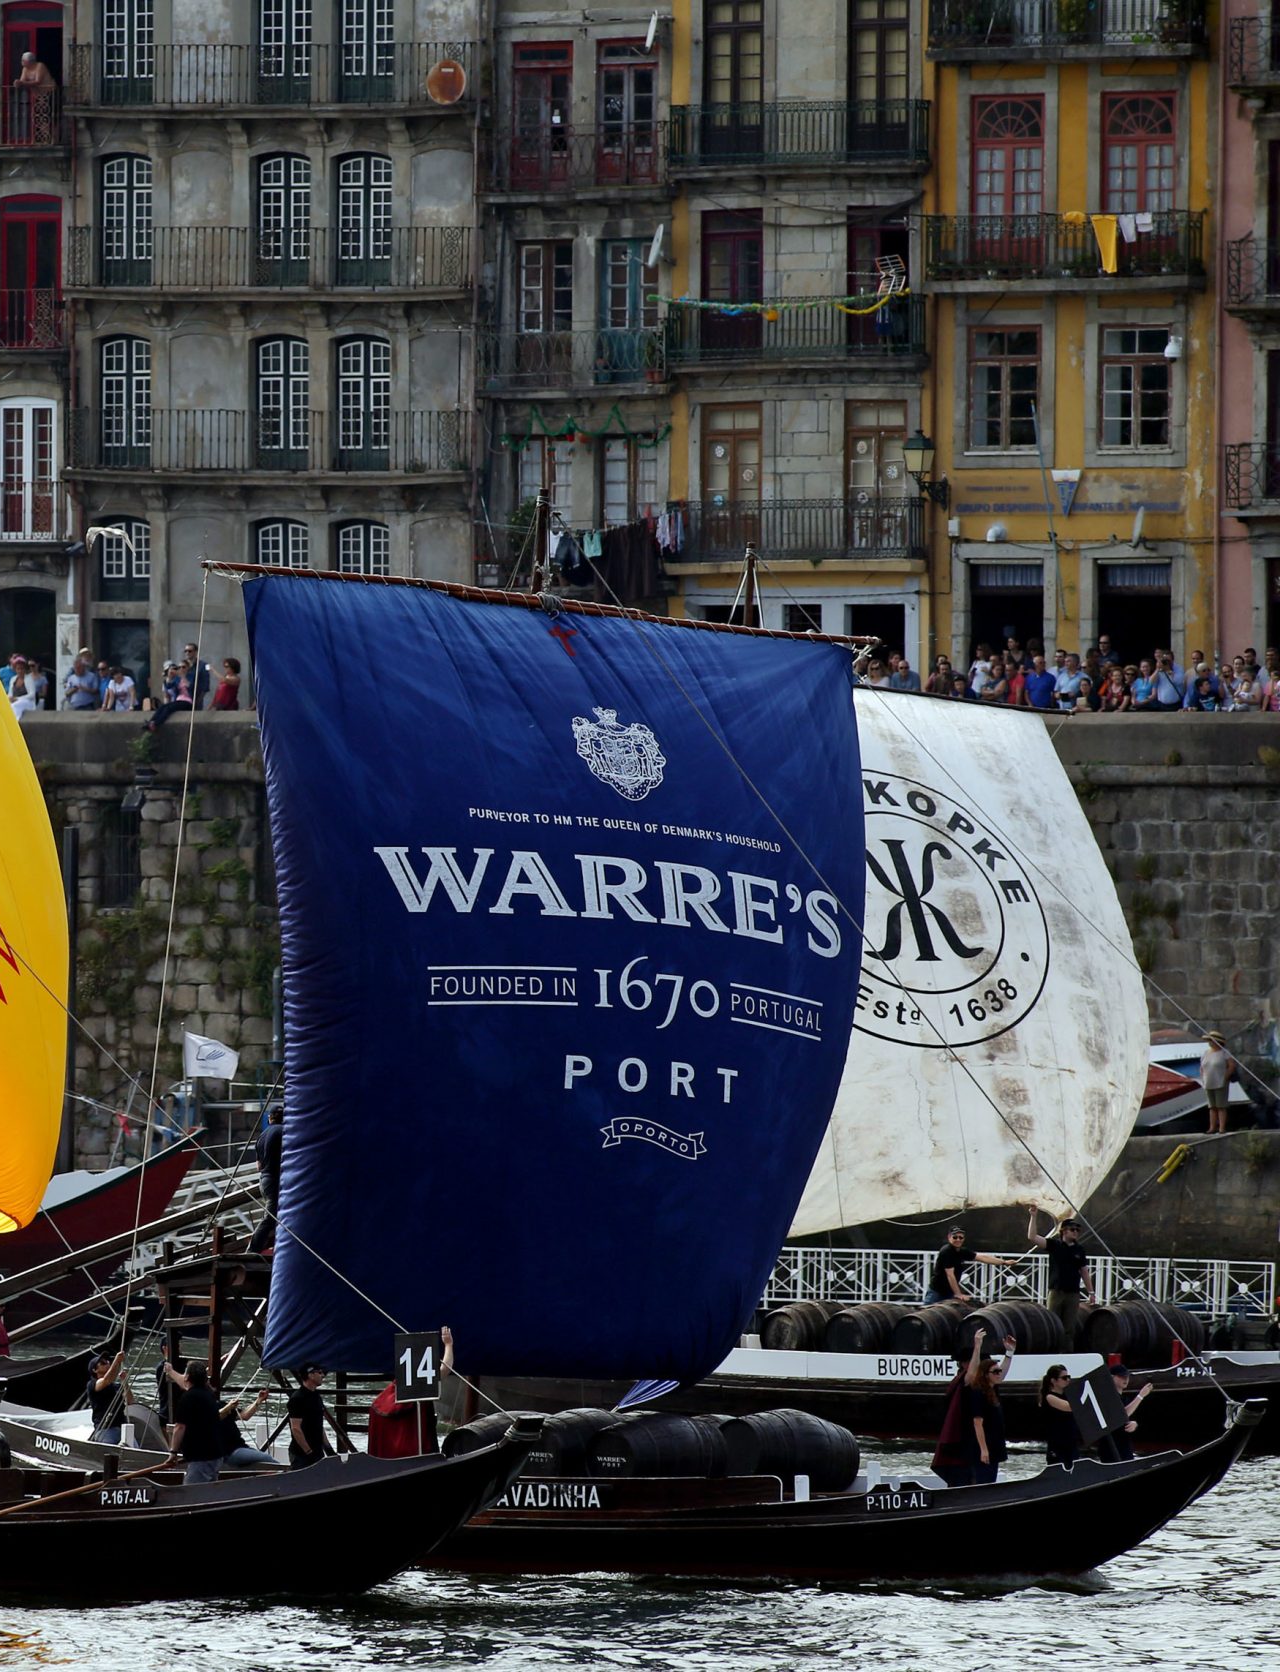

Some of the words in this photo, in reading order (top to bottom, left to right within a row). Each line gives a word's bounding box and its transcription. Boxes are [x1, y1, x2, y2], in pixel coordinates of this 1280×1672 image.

[468, 807, 530, 823] PURVEYOR
[533, 813, 550, 825] TO
[553, 814, 572, 826] HM
[576, 815, 601, 828] THE
[603, 817, 641, 833] QUEEN
[644, 822, 659, 834] OF
[662, 824, 723, 843] DENMARK'S
[725, 832, 782, 854] HOUSEHOLD
[863, 779, 1031, 904] KOPKE
[373, 846, 842, 959] WARRE'S
[431, 976, 544, 996] FOUNDED
[554, 977, 576, 996] IN
[594, 956, 720, 1029] 1670
[949, 978, 1019, 1027] 1638
[731, 993, 822, 1032] PORTUGAL
[564, 1054, 739, 1103] PORT
[619, 1122, 690, 1153] OPORTO
[400, 1346, 436, 1387] 14
[1080, 1380, 1107, 1430] 1
[35, 1435, 70, 1456] DOURO
